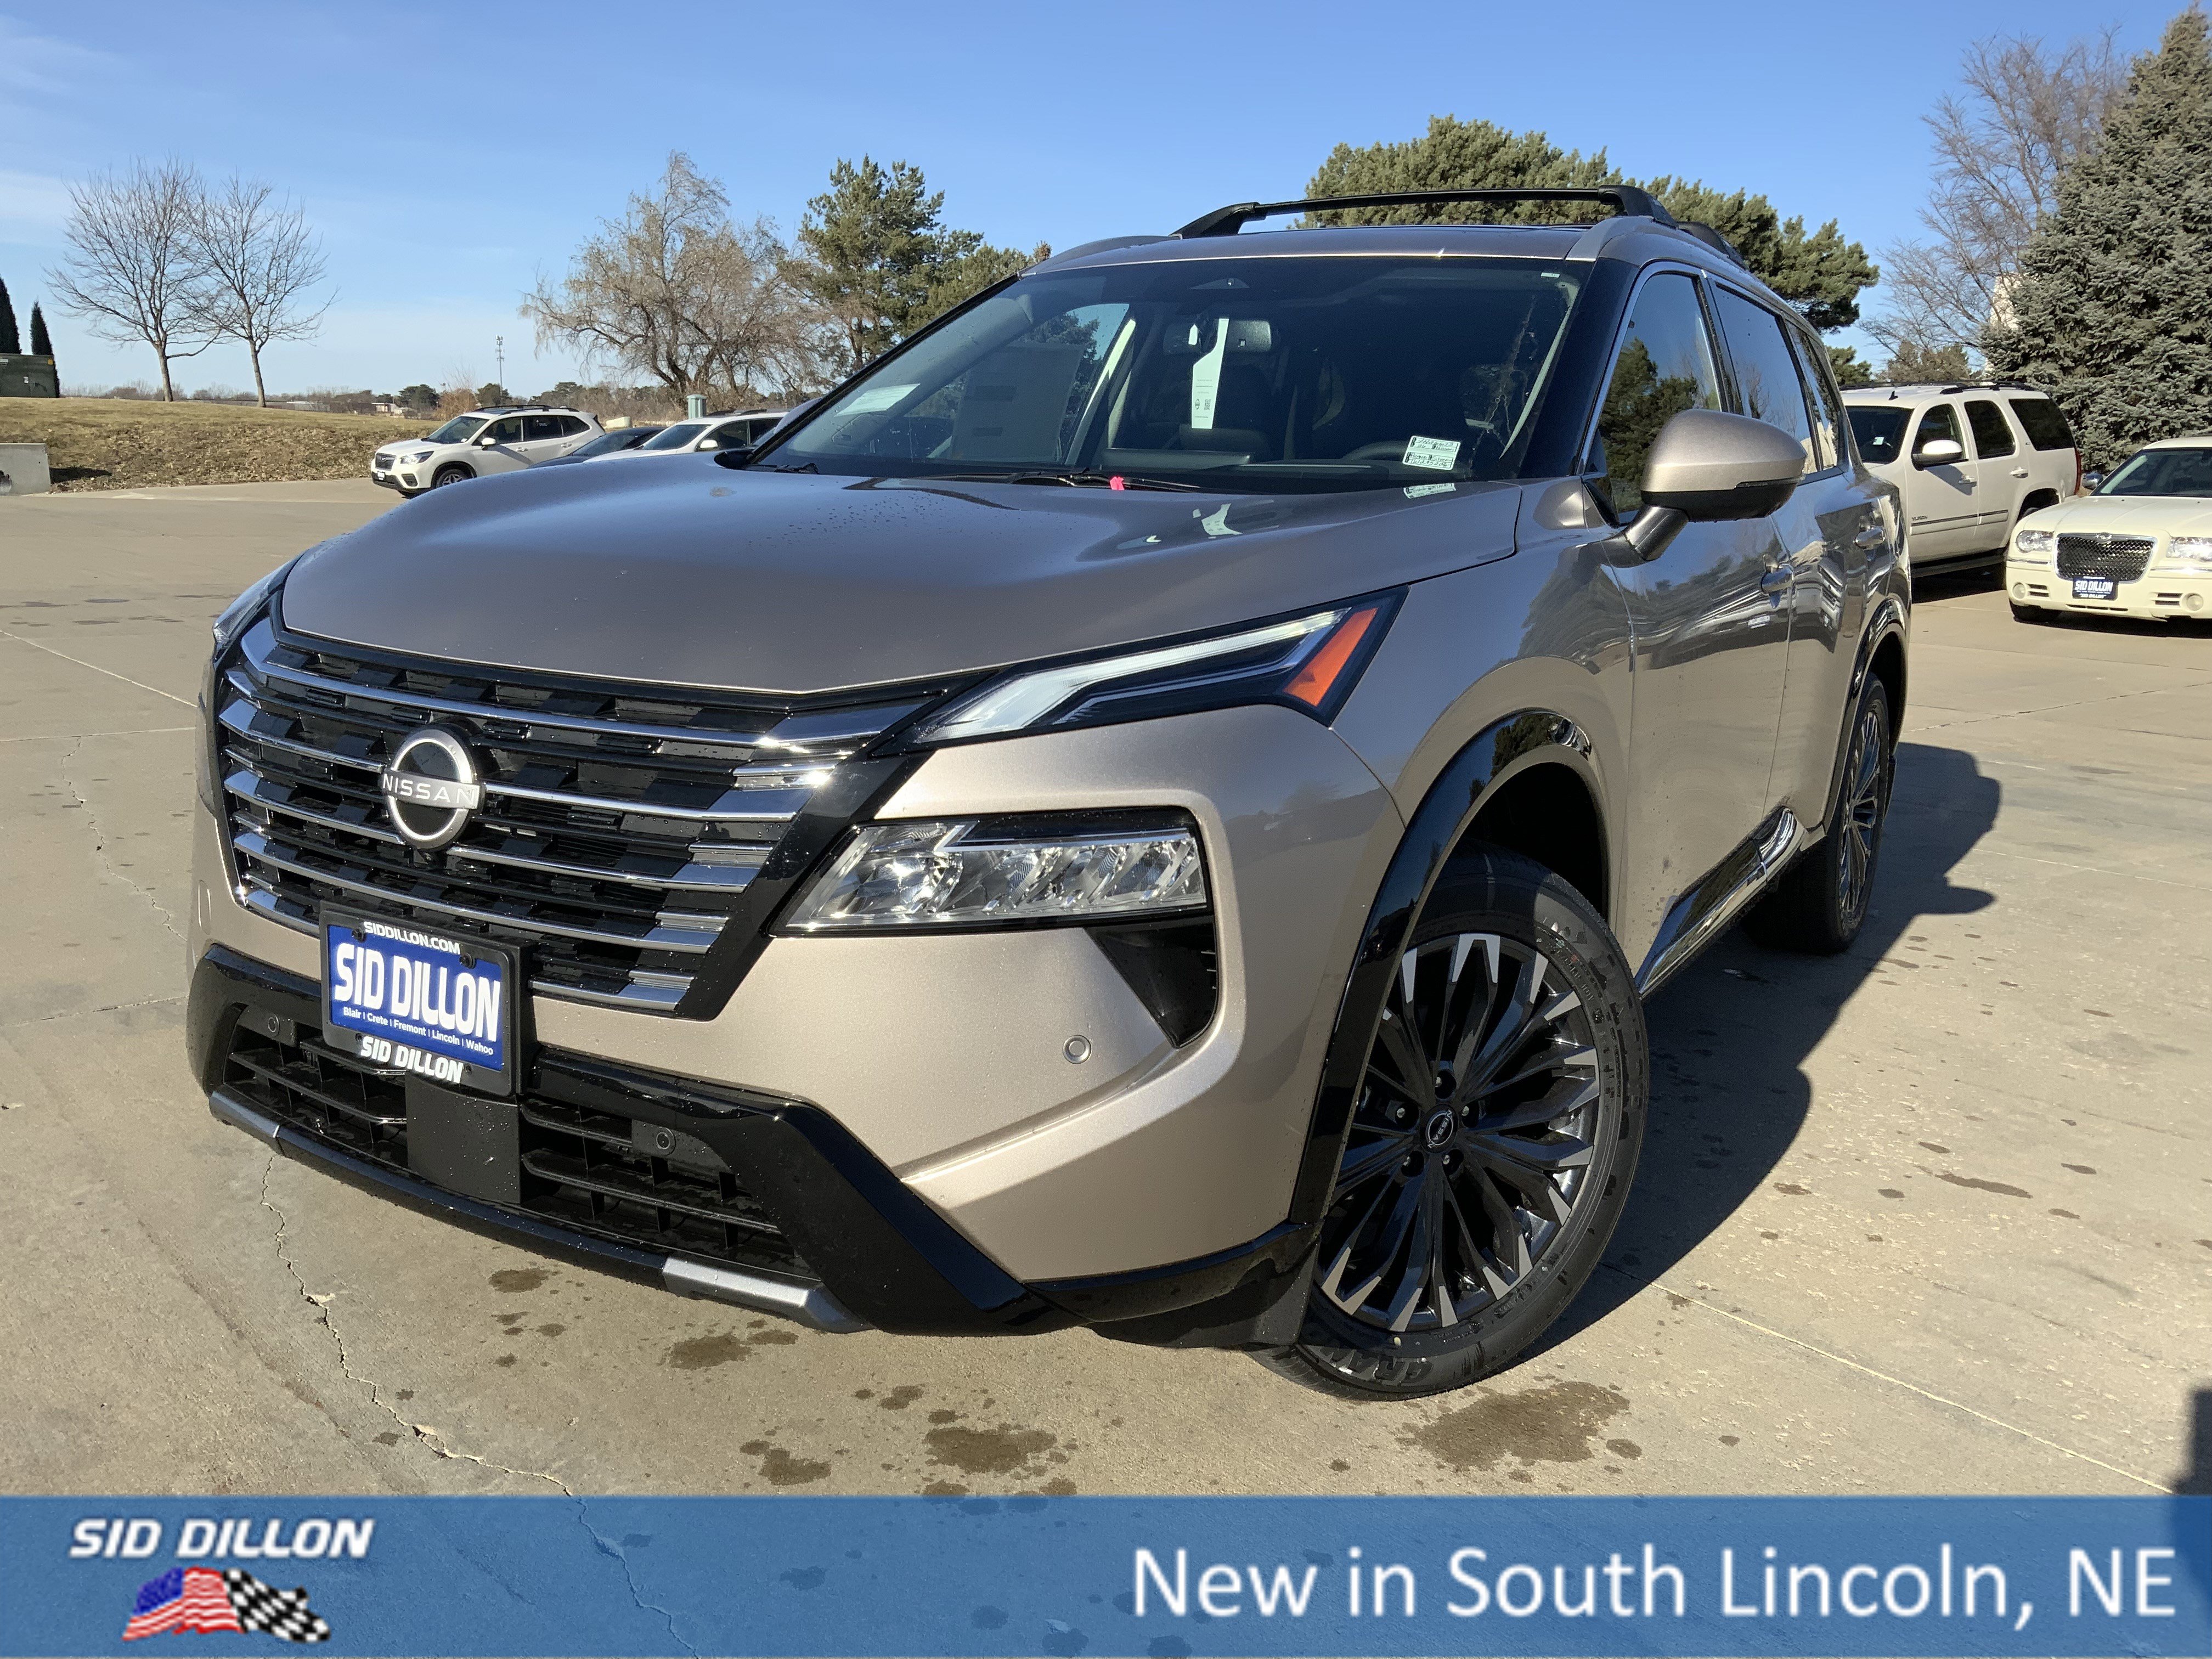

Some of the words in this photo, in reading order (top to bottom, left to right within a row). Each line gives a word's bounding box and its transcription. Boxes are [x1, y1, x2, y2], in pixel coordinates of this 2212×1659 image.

[2075, 580, 2087, 590] SID
[2087, 581, 2113, 592] DILLON
[382, 773, 475, 804] NISSAN
[363, 921, 461, 955] SIDDILLON.COM
[334, 942, 384, 1010] SID
[391, 955, 501, 1042] DILLON
[343, 1006, 362, 1020] Blair
[367, 1012, 388, 1026] Crete
[393, 1019, 427, 1036] Fremont
[432, 1030, 460, 1046] Lincoln
[465, 1039, 494, 1056] Wahoo
[360, 1035, 392, 1063] SID
[394, 1045, 464, 1084] DILLON
[1427, 1109, 1453, 1149] NISSAN
